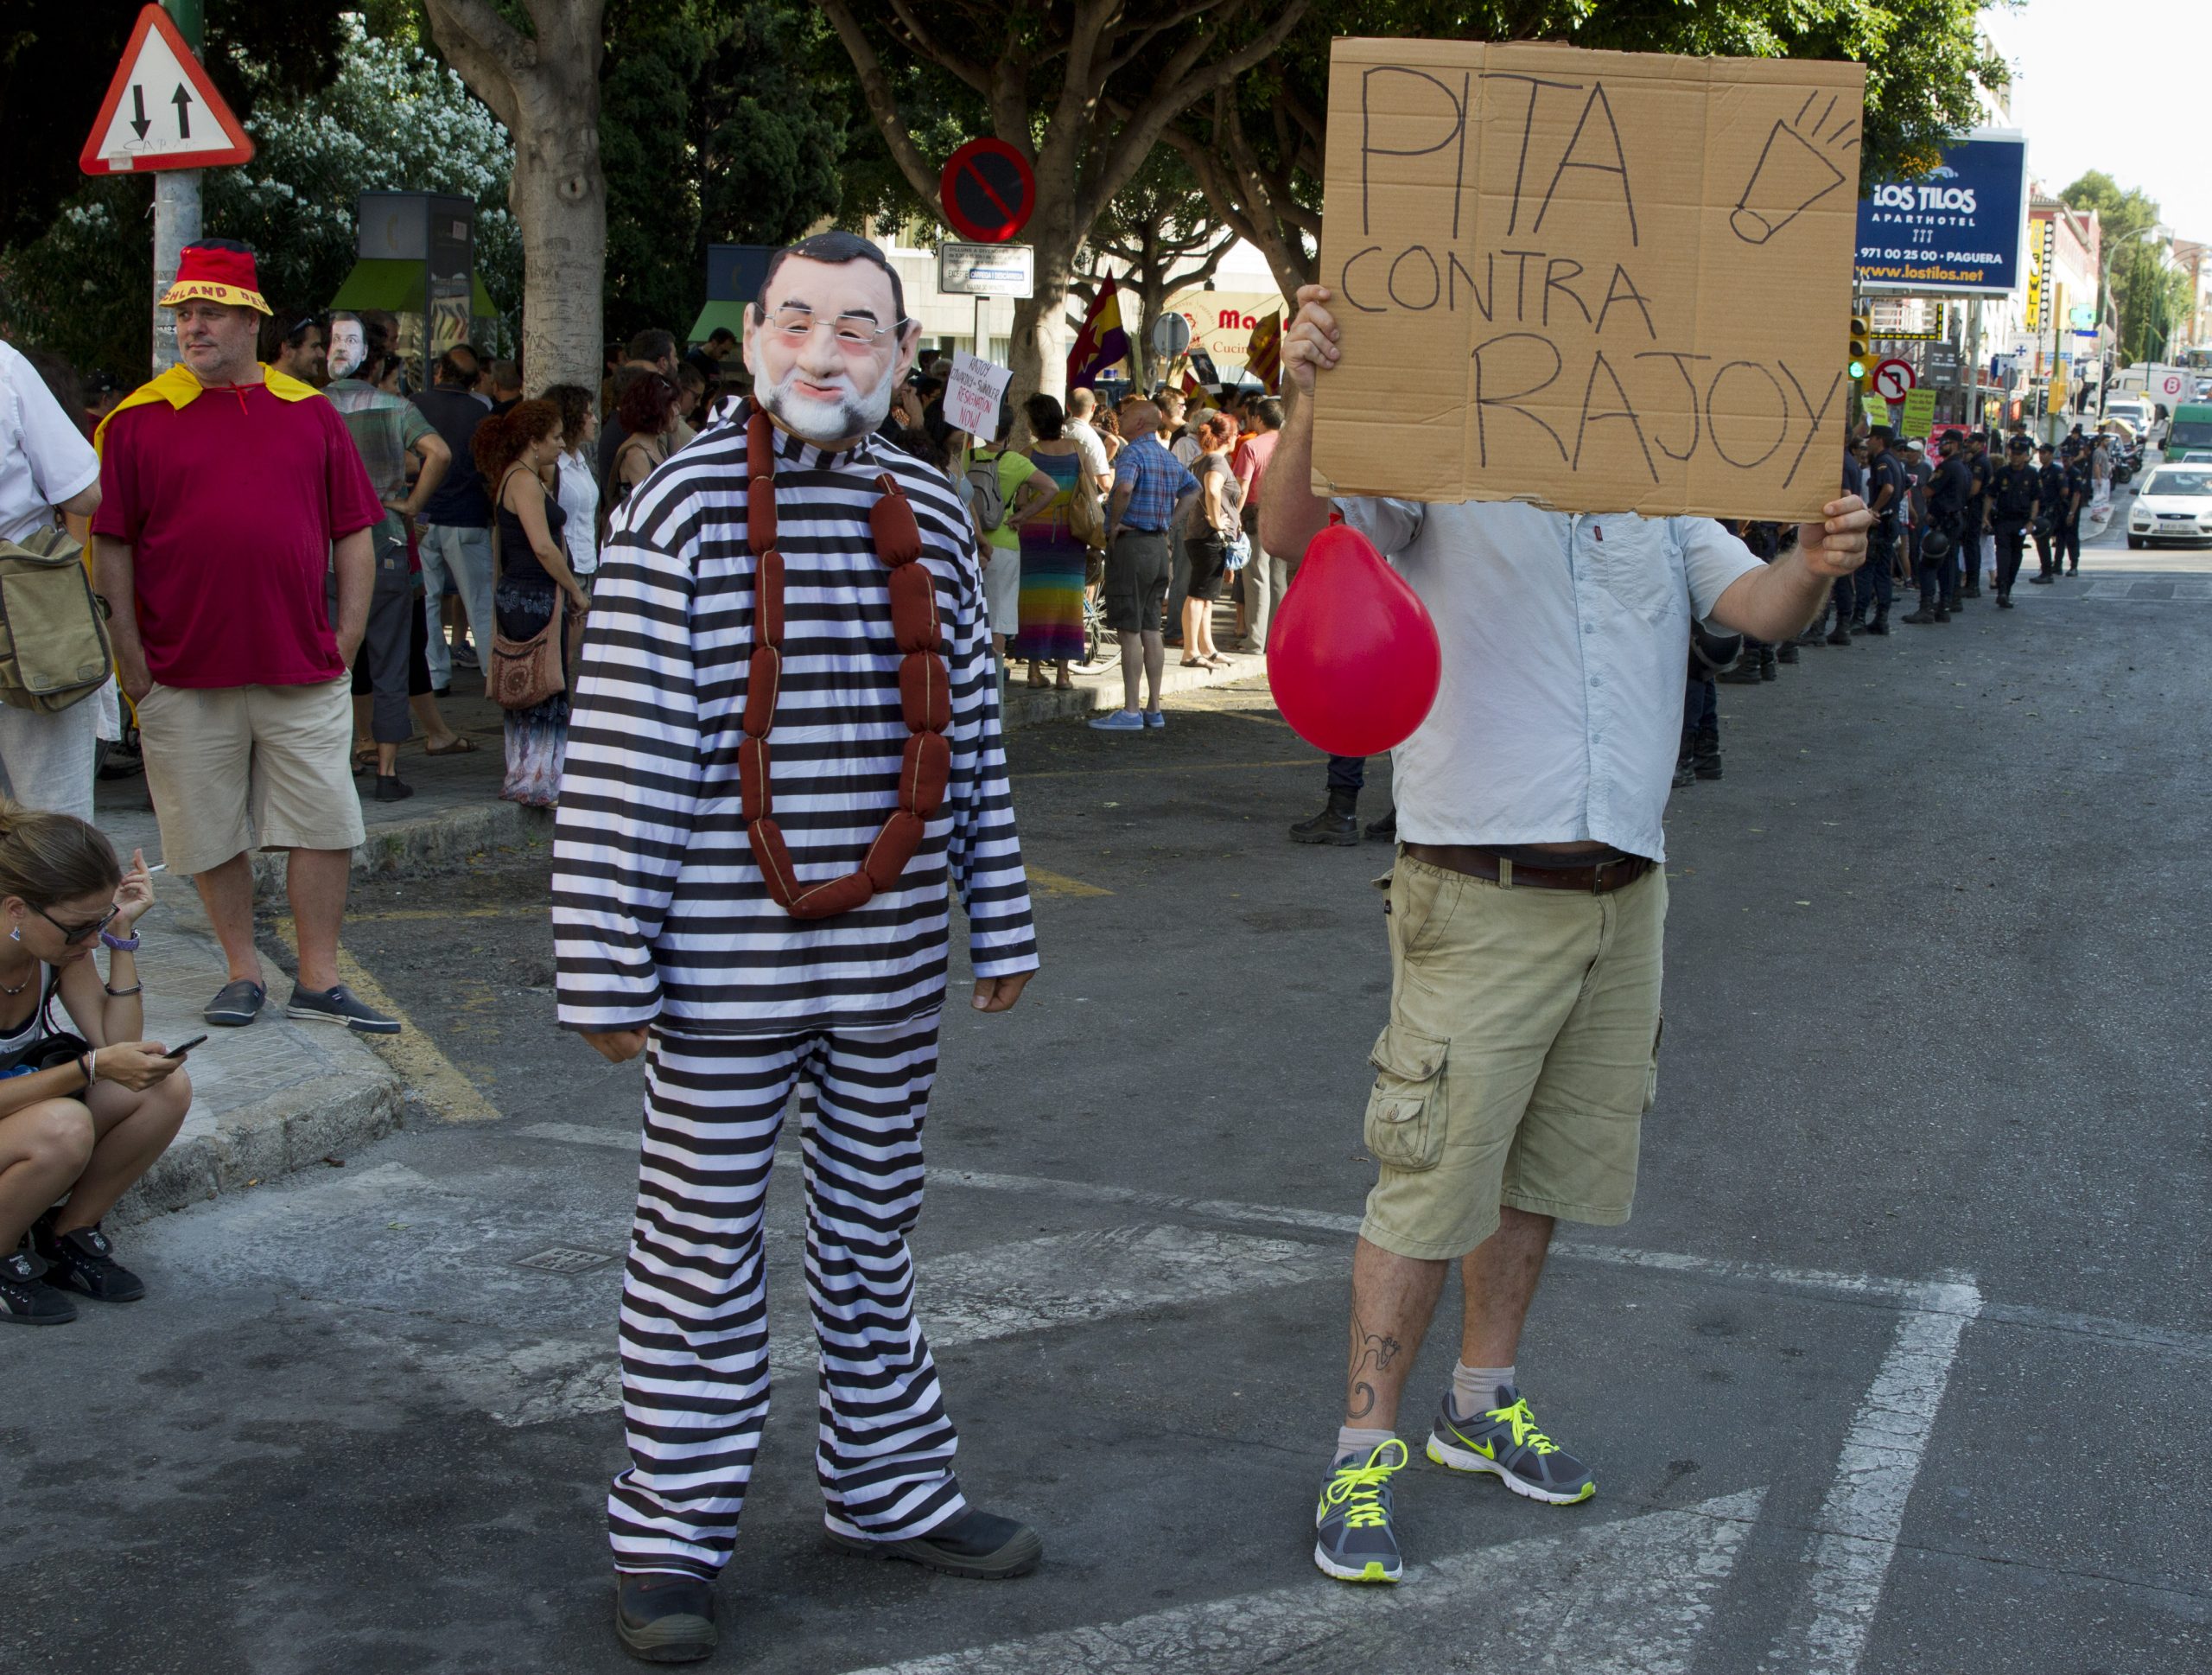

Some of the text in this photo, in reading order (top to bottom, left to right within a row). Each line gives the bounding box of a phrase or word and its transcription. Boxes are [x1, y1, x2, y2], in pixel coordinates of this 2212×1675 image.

[1361, 66, 1638, 247] PITA
[1873, 184, 1977, 214] LOS TILOS
[1872, 213, 1976, 227] APARTHOTEL
[1860, 247, 1881, 258] 971
[1885, 248, 1902, 259] 00
[1904, 249, 1918, 260] 25
[1921, 251, 1937, 261] 00
[1946, 252, 2003, 264] PAGUERA
[1855, 264, 1984, 282] www.lostilos.net
[1341, 245, 1656, 341] CONTRA
[969, 358, 992, 378] RAJOY
[957, 386, 993, 413] RESIGNATION
[1471, 332, 1842, 489] RAJOY
[959, 406, 982, 433] NOW!
